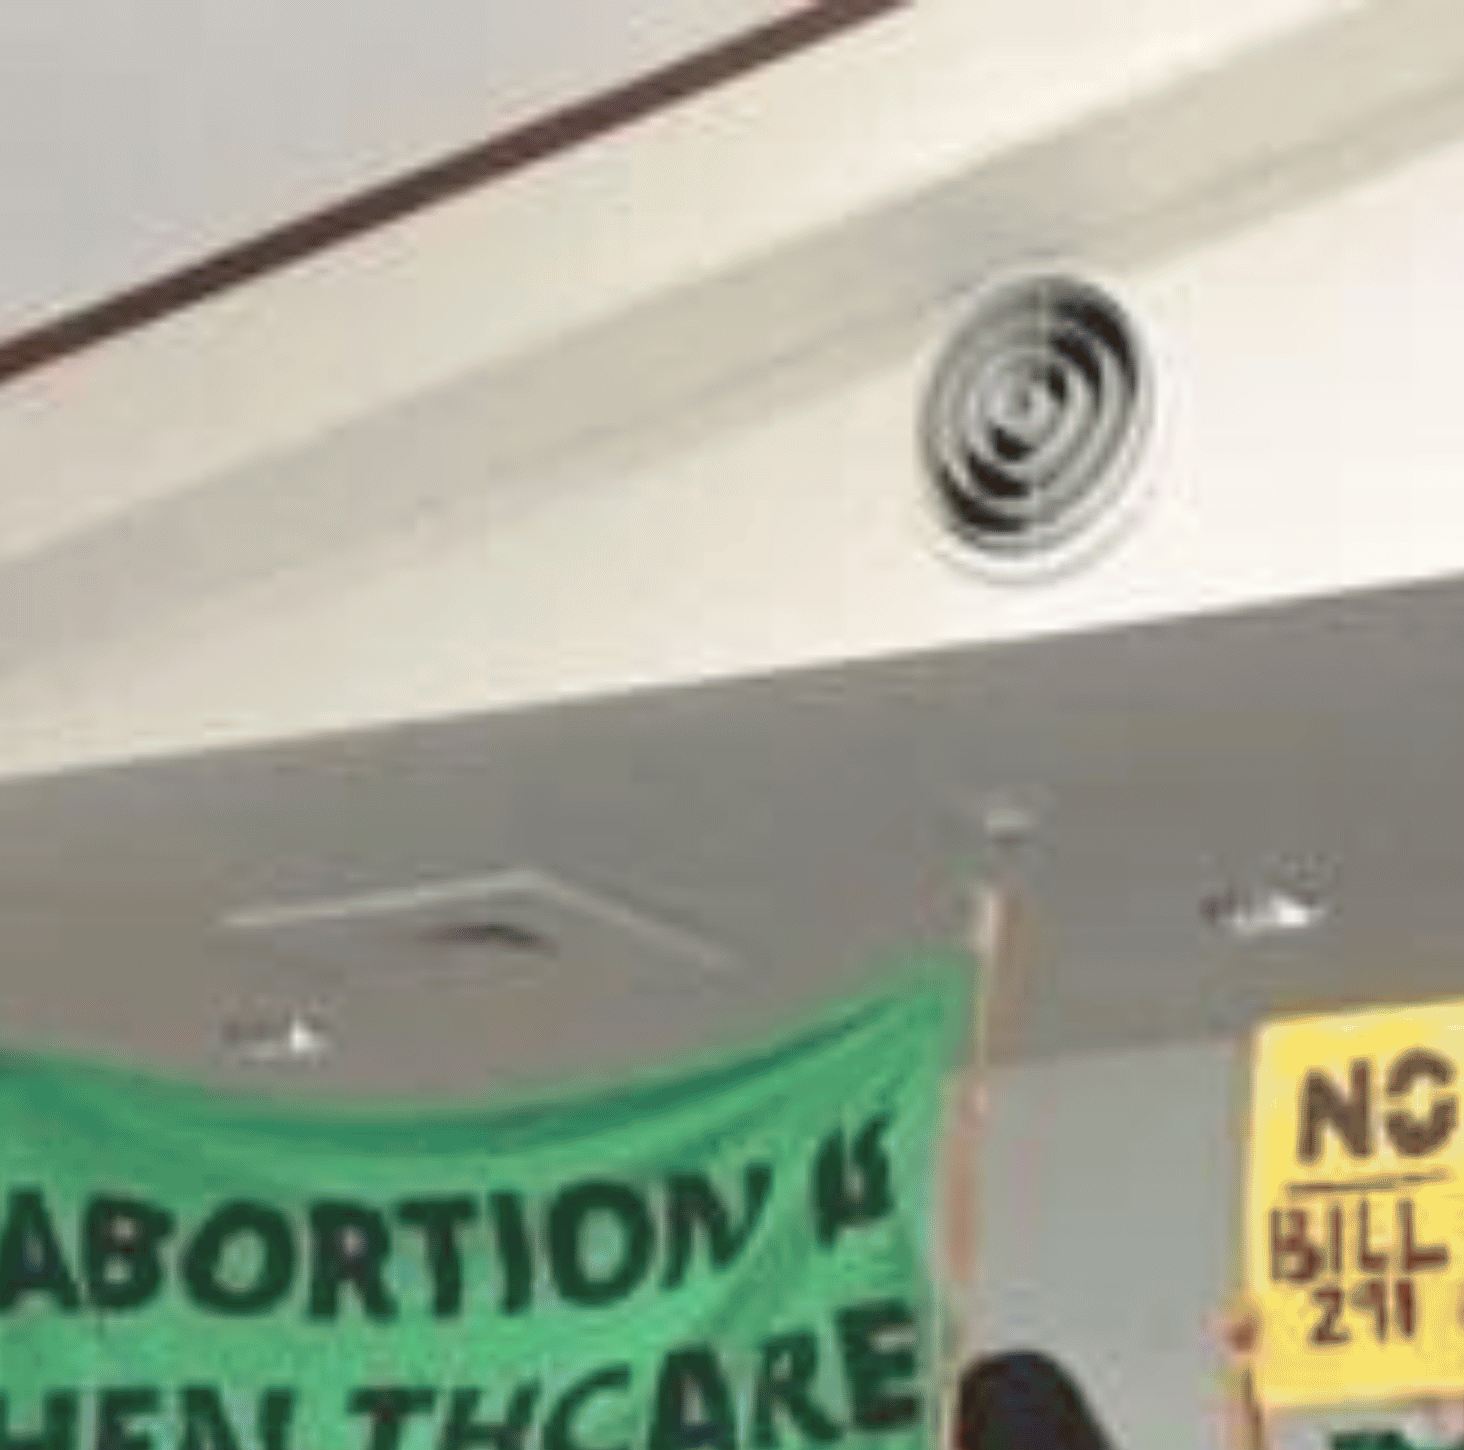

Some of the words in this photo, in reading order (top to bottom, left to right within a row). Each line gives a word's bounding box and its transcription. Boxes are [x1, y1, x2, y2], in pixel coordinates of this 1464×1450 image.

[1295, 1047, 1459, 1165] NO
[0, 1162, 775, 1324] ABORTION
[810, 1112, 896, 1249] IS
[1268, 1197, 1451, 1284] BILL
